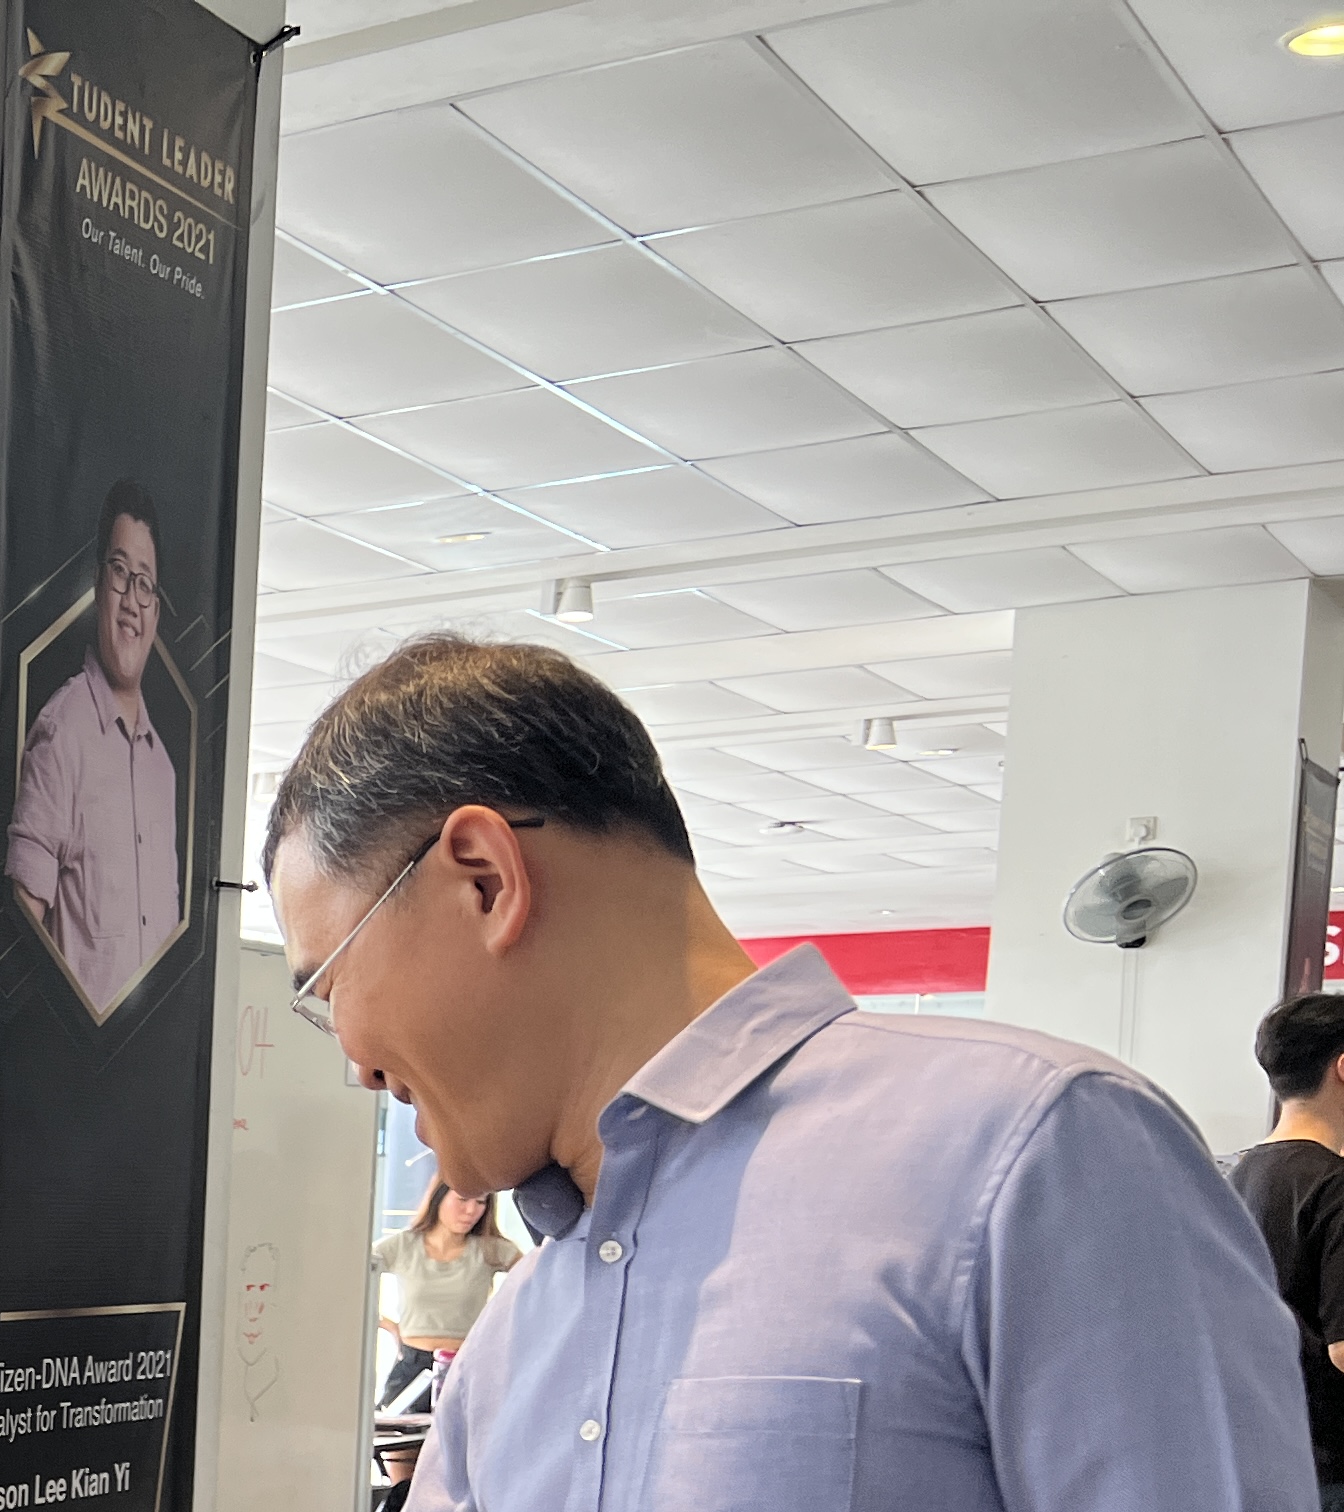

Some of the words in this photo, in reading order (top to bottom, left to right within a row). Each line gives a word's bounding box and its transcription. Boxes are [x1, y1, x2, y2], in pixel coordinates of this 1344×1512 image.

[162, 127, 235, 204] LEADER
[76, 156, 167, 238] AWARDS
[172, 210, 214, 264] 2021
[82, 218, 104, 245] Our
[109, 230, 145, 267] Talent.
[149, 253, 171, 280] Our
[173, 266, 205, 299] Pride.
[83, 1352, 133, 1385] Award
[137, 1350, 171, 1379] 2021
[36, 1405, 57, 1432] for
[59, 1394, 163, 1429] Transformation
[35, 1474, 67, 1505] Lee
[71, 1468, 109, 1499] Kian
[114, 1462, 130, 1492] Yi
